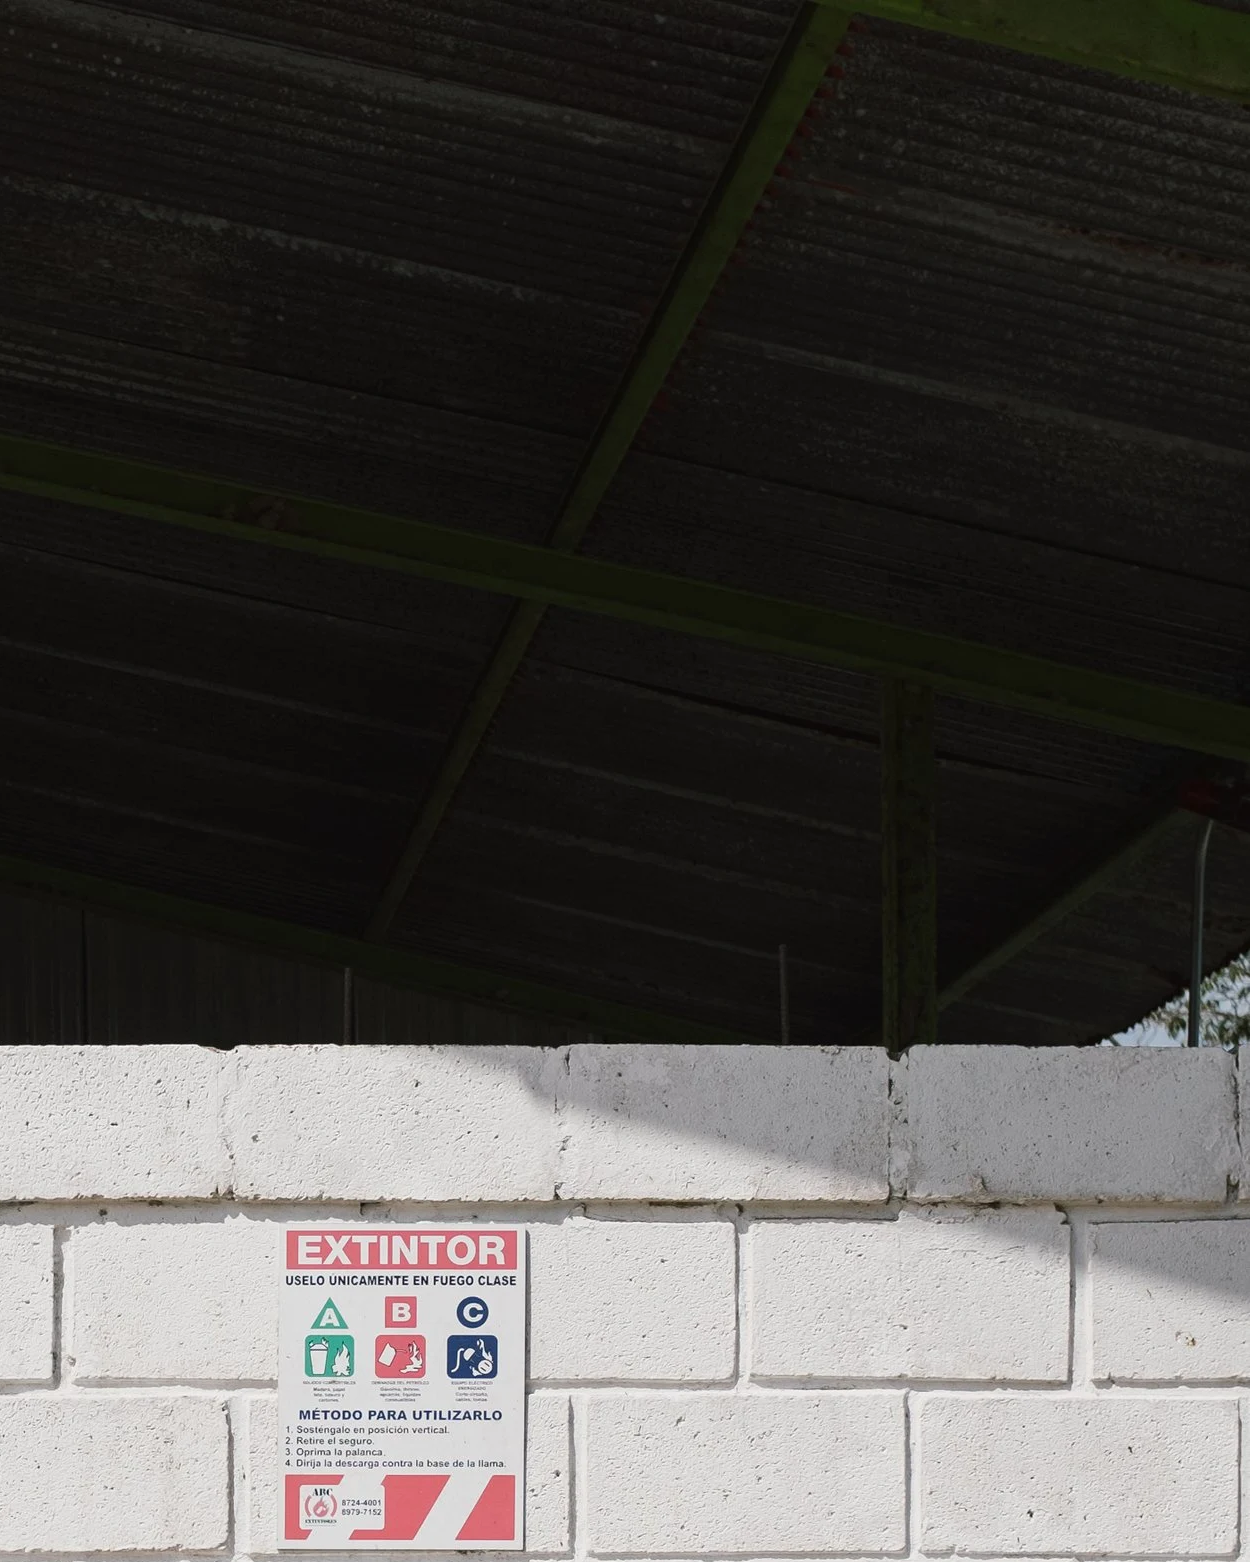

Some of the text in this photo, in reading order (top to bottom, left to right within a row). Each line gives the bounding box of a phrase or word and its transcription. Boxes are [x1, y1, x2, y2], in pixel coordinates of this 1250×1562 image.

[297, 1235, 506, 1266] EXTINTOR
[285, 1273, 517, 1286] USELO ÚNICAMENTE EN FUEGO CLASE
[319, 1308, 341, 1327] A
[392, 1303, 412, 1322] B
[463, 1303, 484, 1323] C
[299, 1407, 502, 1421] MÉTODO PARA UTILIZARLO
[285, 1426, 294, 1434] 1.
[296, 1425, 351, 1436] Sosténgalo
[367, 1425, 409, 1436] posición
[412, 1426, 450, 1434] vertical.
[285, 1437, 375, 1447] 2. Retire el seguro.
[285, 1448, 387, 1457] 3. Oprima la palanca.
[285, 1459, 294, 1467] 4.
[296, 1459, 321, 1469] Dirija
[324, 1459, 332, 1467] la
[335, 1459, 379, 1469] descarga
[416, 1459, 424, 1467] la
[427, 1459, 450, 1467] base
[452, 1459, 465, 1467] de
[467, 1459, 475, 1467] la
[478, 1459, 507, 1468] llama.
[312, 1488, 333, 1497] ABC
[341, 1499, 382, 1507] 8724-4001
